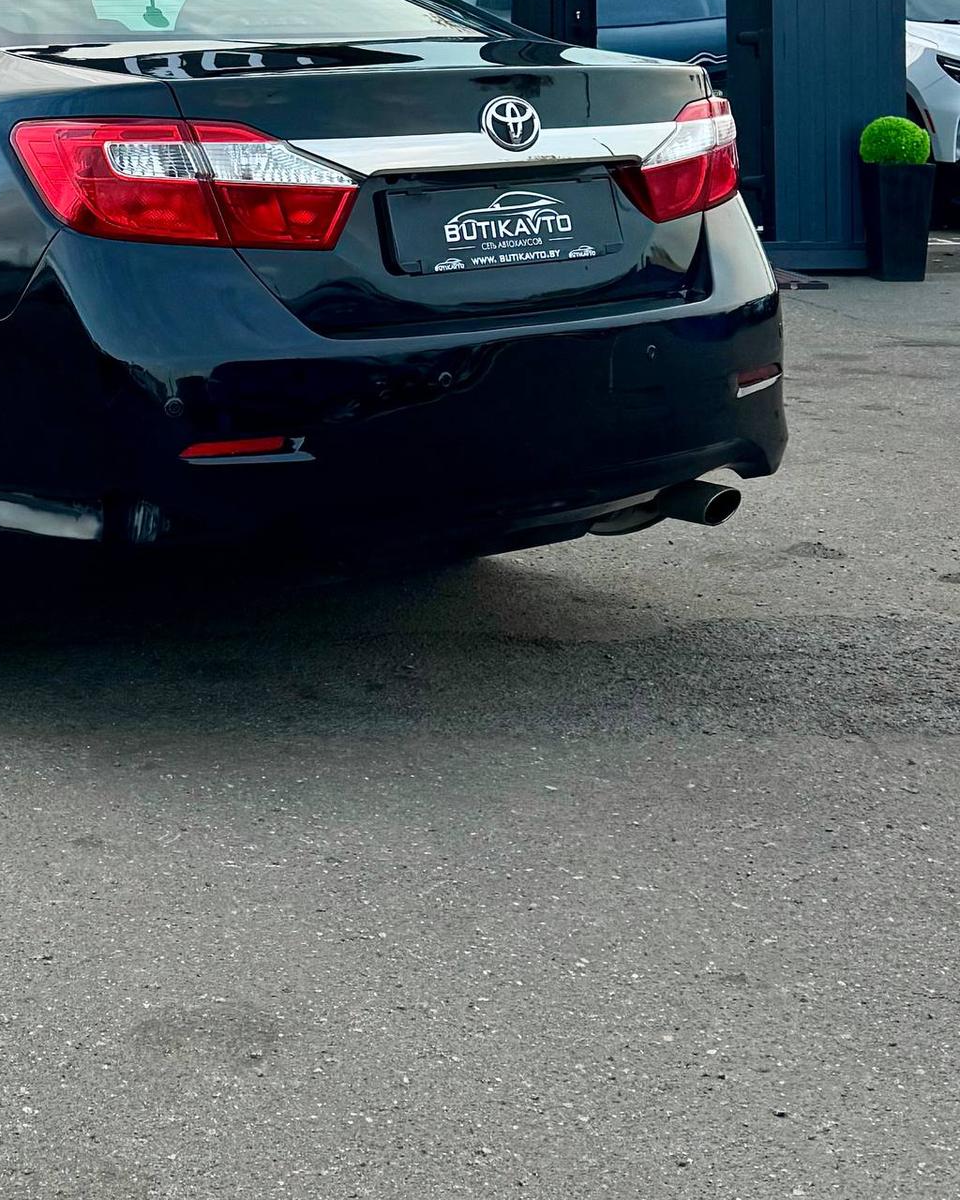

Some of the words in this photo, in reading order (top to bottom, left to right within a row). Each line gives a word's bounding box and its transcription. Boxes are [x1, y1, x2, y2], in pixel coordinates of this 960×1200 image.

[444, 214, 572, 243] BUTIKAVTO
[481, 241, 497, 250] СЕТЬ
[498, 238, 543, 249] АВТОХАУСОВ
[471, 256, 497, 266] WWW.
[499, 249, 560, 263] BUTIKAVTO.BY
